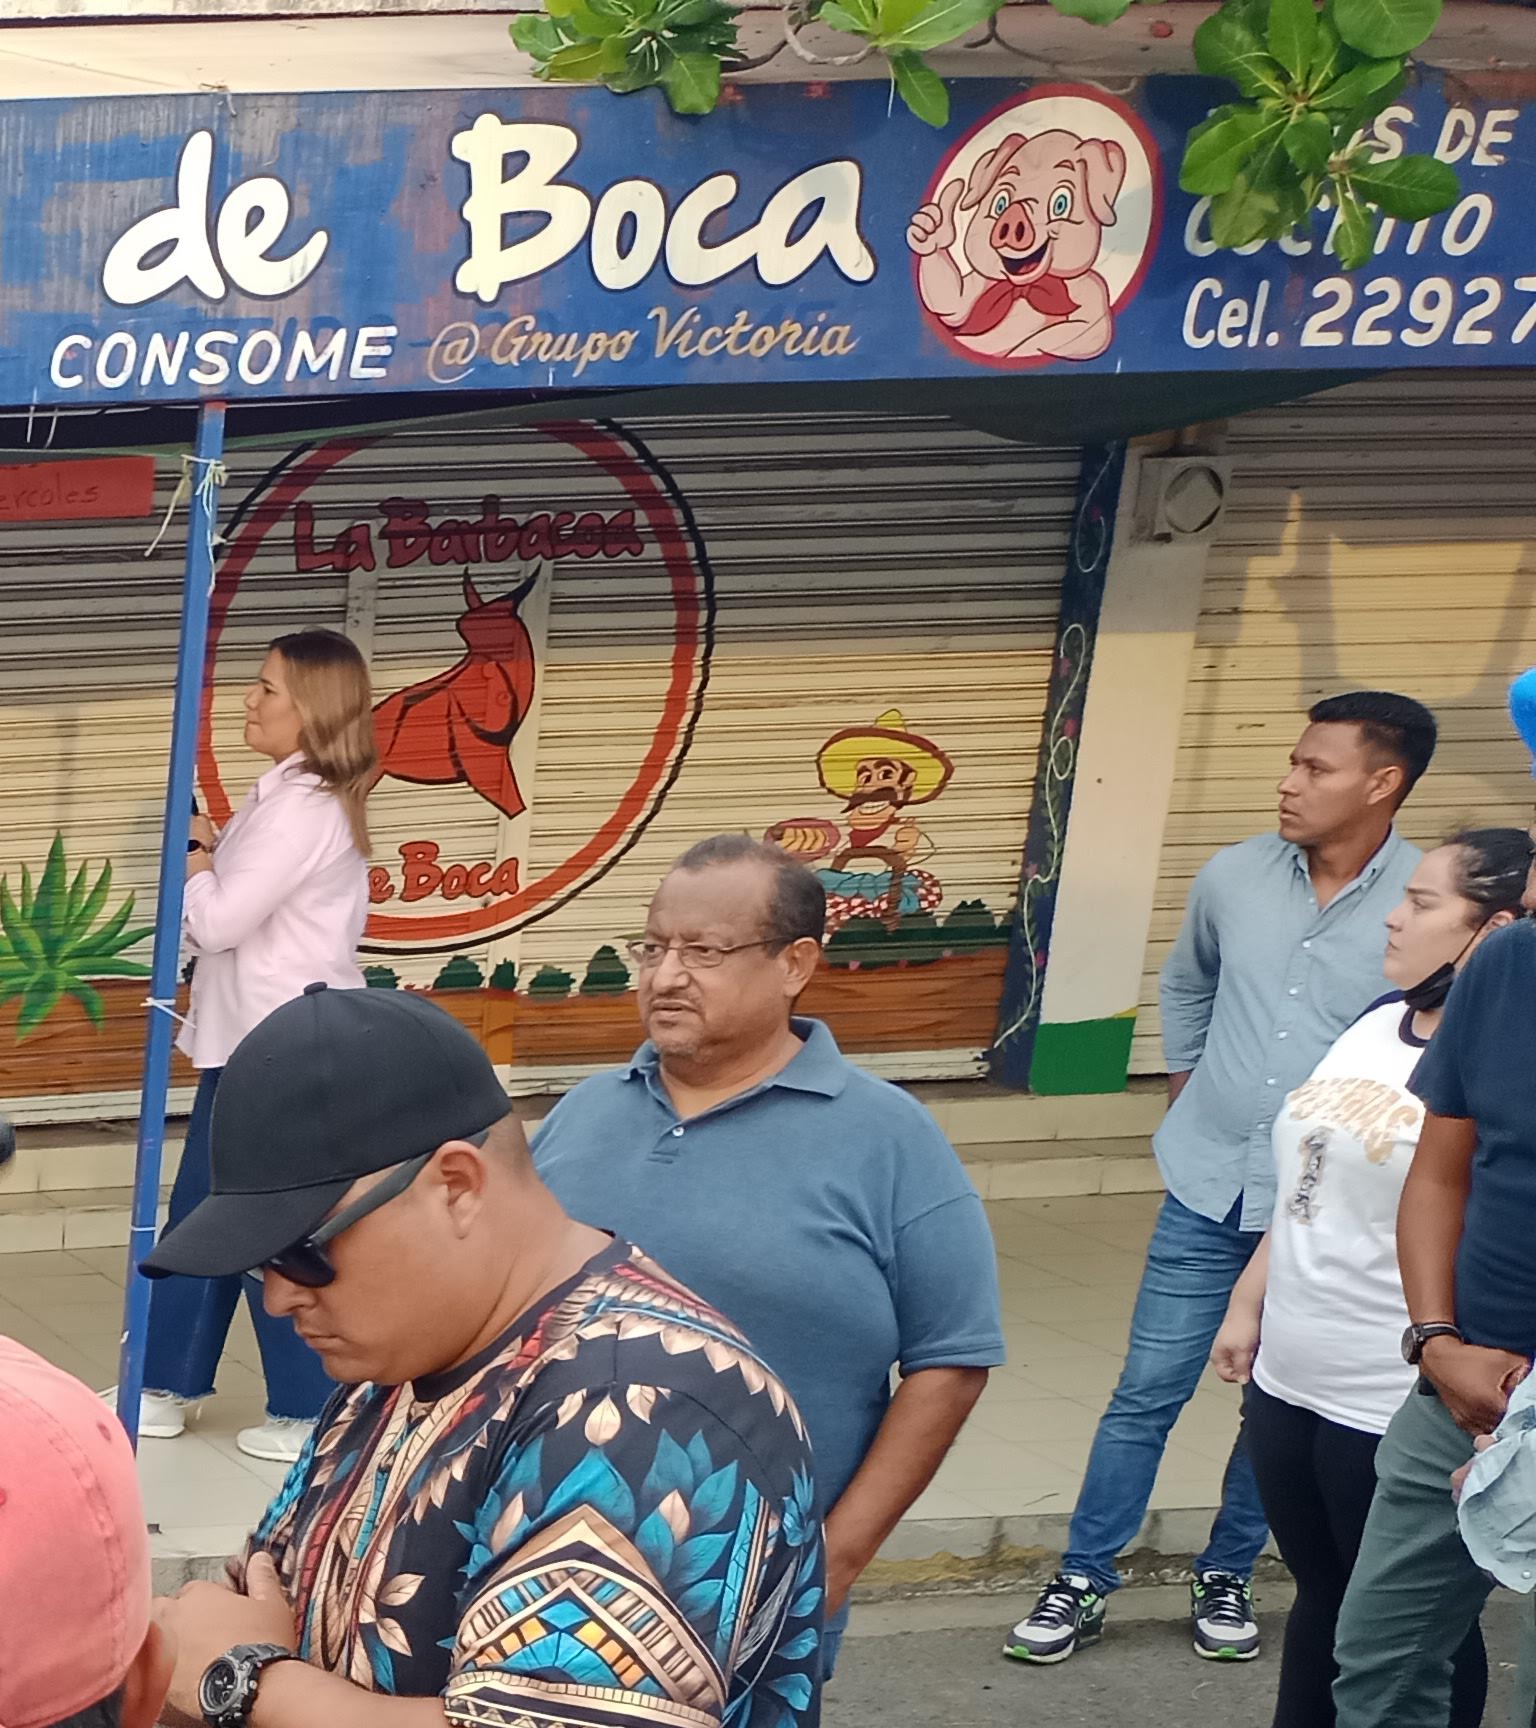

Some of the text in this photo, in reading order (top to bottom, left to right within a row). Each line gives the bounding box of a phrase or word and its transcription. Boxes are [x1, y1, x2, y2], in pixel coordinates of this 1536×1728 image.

[1433, 107, 1520, 166] DE
[102, 129, 329, 306] de
[450, 112, 878, 302] Boca
[491, 316, 638, 379] Grupo
[647, 306, 858, 361] Victoria
[1183, 278, 1278, 348] Cel.
[49, 325, 399, 389] CONSOME
[294, 495, 645, 572] La Barbacoa
[399, 841, 519, 902] Boca
